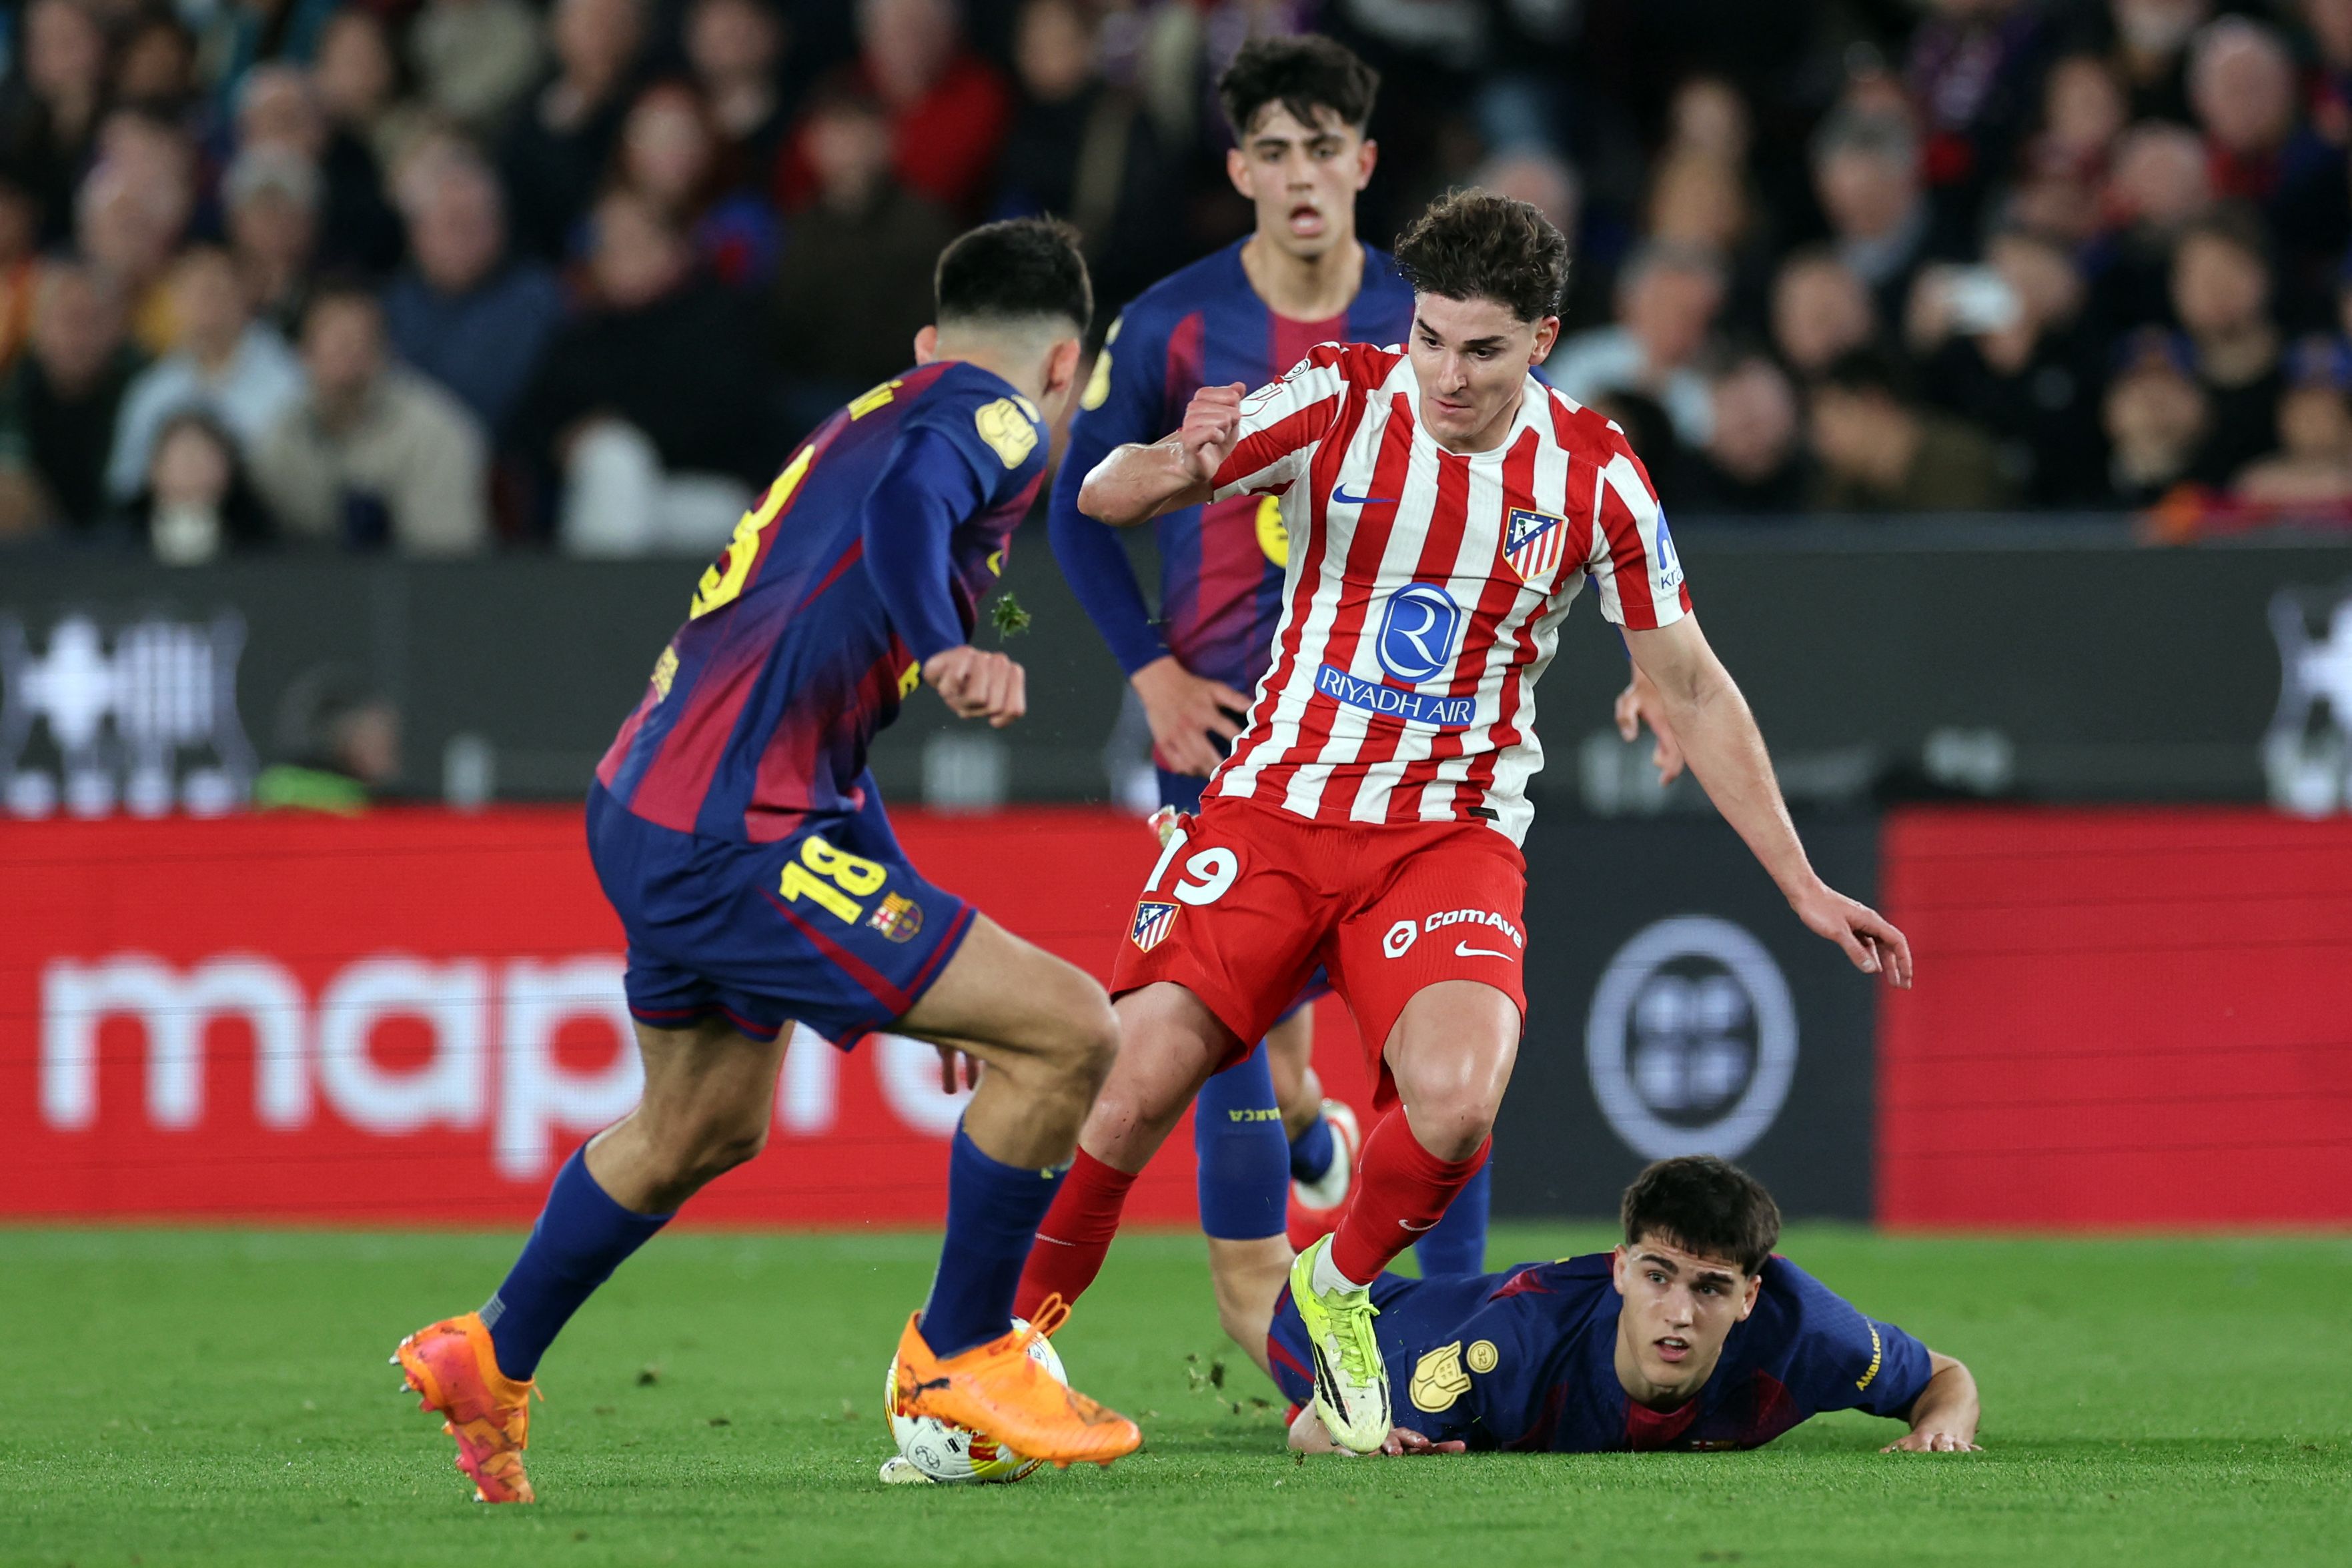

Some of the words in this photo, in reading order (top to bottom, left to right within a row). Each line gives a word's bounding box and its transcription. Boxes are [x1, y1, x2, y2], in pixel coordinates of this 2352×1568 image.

[1321, 668, 1422, 717] RIYADH
[1426, 700, 1471, 722] AIR
[778, 835, 887, 925] 18
[1137, 828, 1239, 906] 19
[1477, 1348, 1488, 1366] 32
